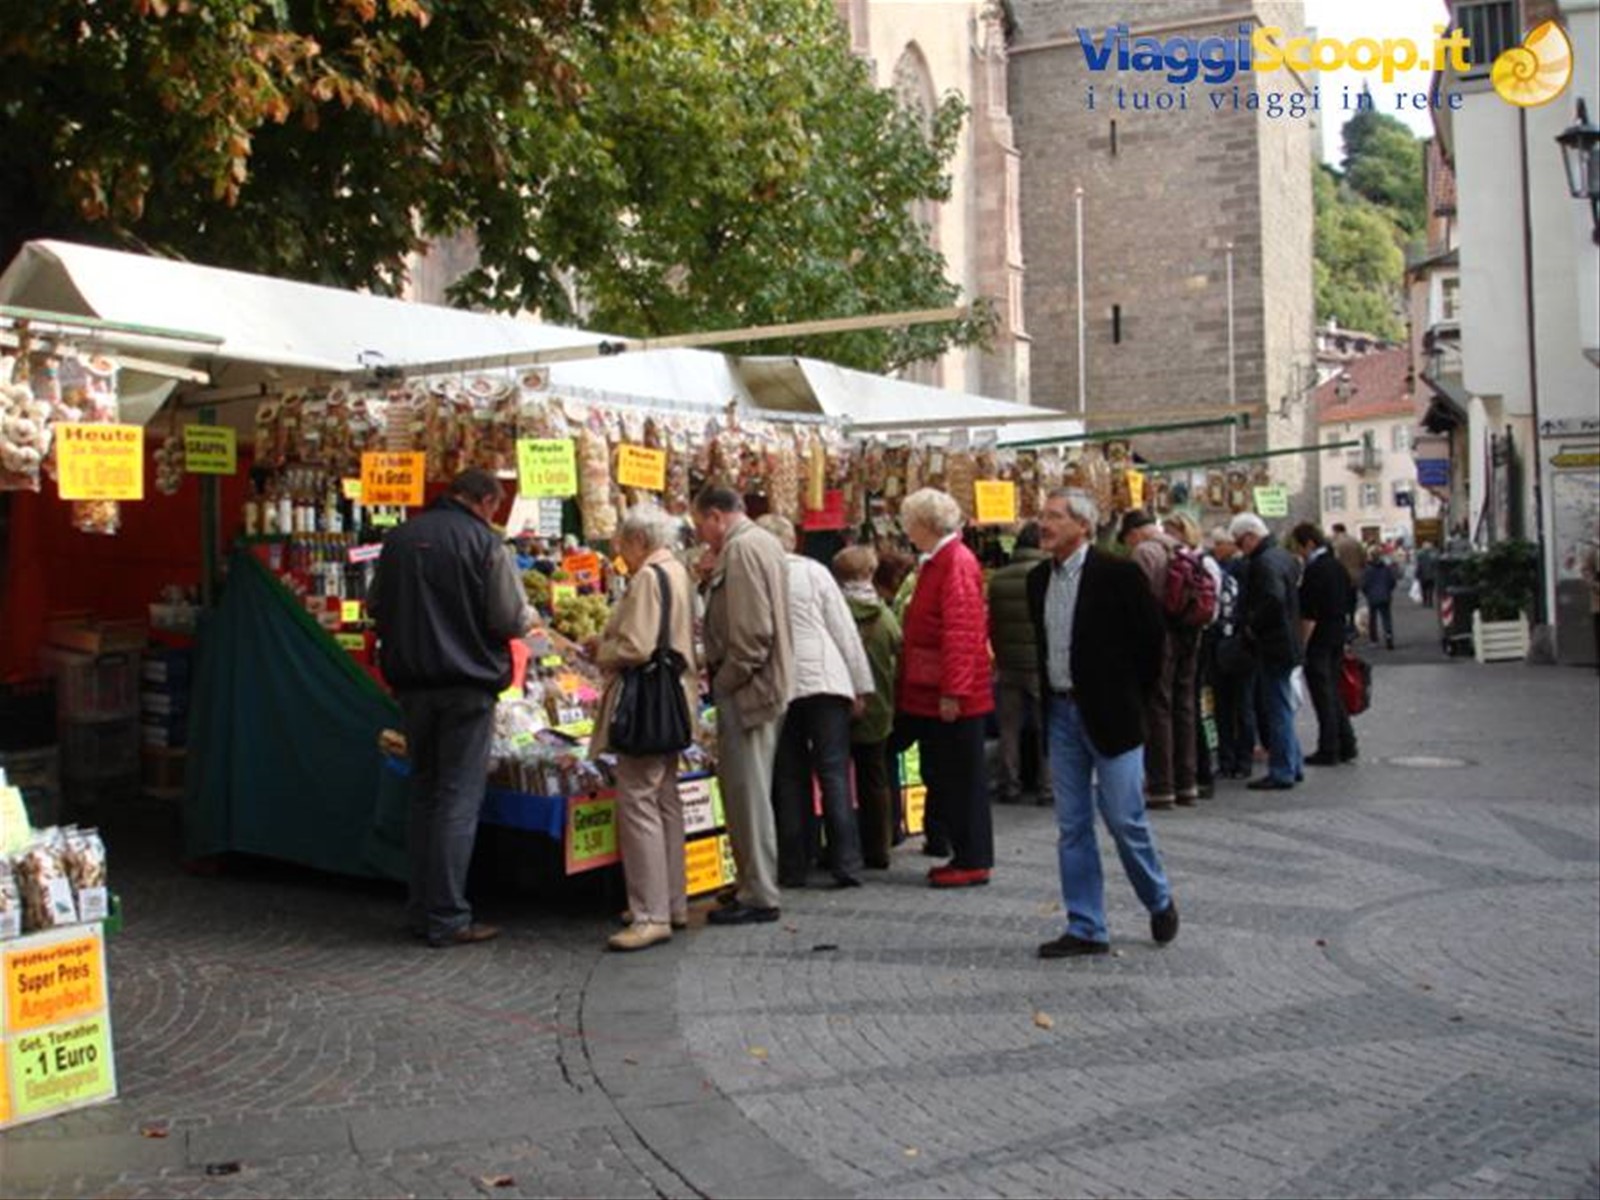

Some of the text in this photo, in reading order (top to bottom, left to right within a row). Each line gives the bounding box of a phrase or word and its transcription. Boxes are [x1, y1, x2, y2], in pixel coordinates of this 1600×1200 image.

[64, 427, 137, 442] Heute
[17, 959, 91, 994] Super Preis
[18, 984, 92, 1021] Angebot
[48, 1022, 100, 1046] Tomaten
[38, 1051, 49, 1076] 1
[55, 1043, 98, 1071] Euro
